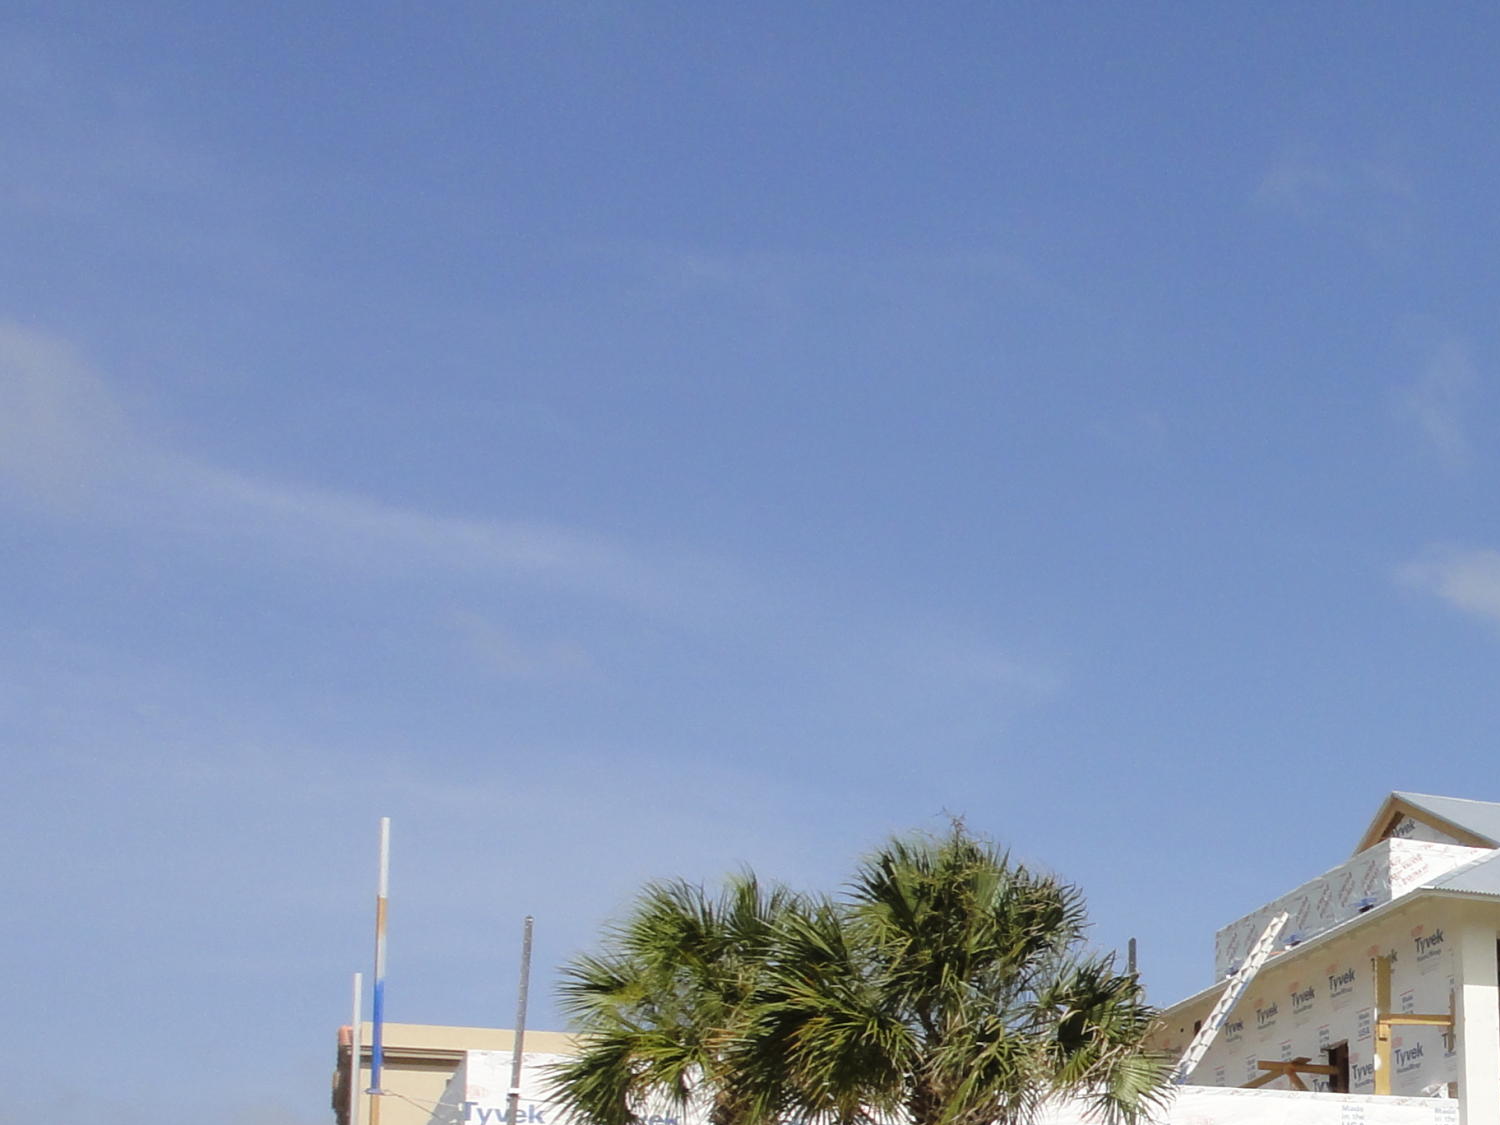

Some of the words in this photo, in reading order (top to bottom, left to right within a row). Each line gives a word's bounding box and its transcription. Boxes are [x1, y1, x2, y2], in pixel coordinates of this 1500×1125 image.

[1414, 928, 1443, 954] Tyvek
[1328, 968, 1355, 991] Tyvek
[1291, 986, 1315, 1007] Tyvek
[1256, 1002, 1278, 1024] Tyvek
[1394, 1042, 1424, 1066] Tyvek
[1352, 1063, 1374, 1080] Tyve
